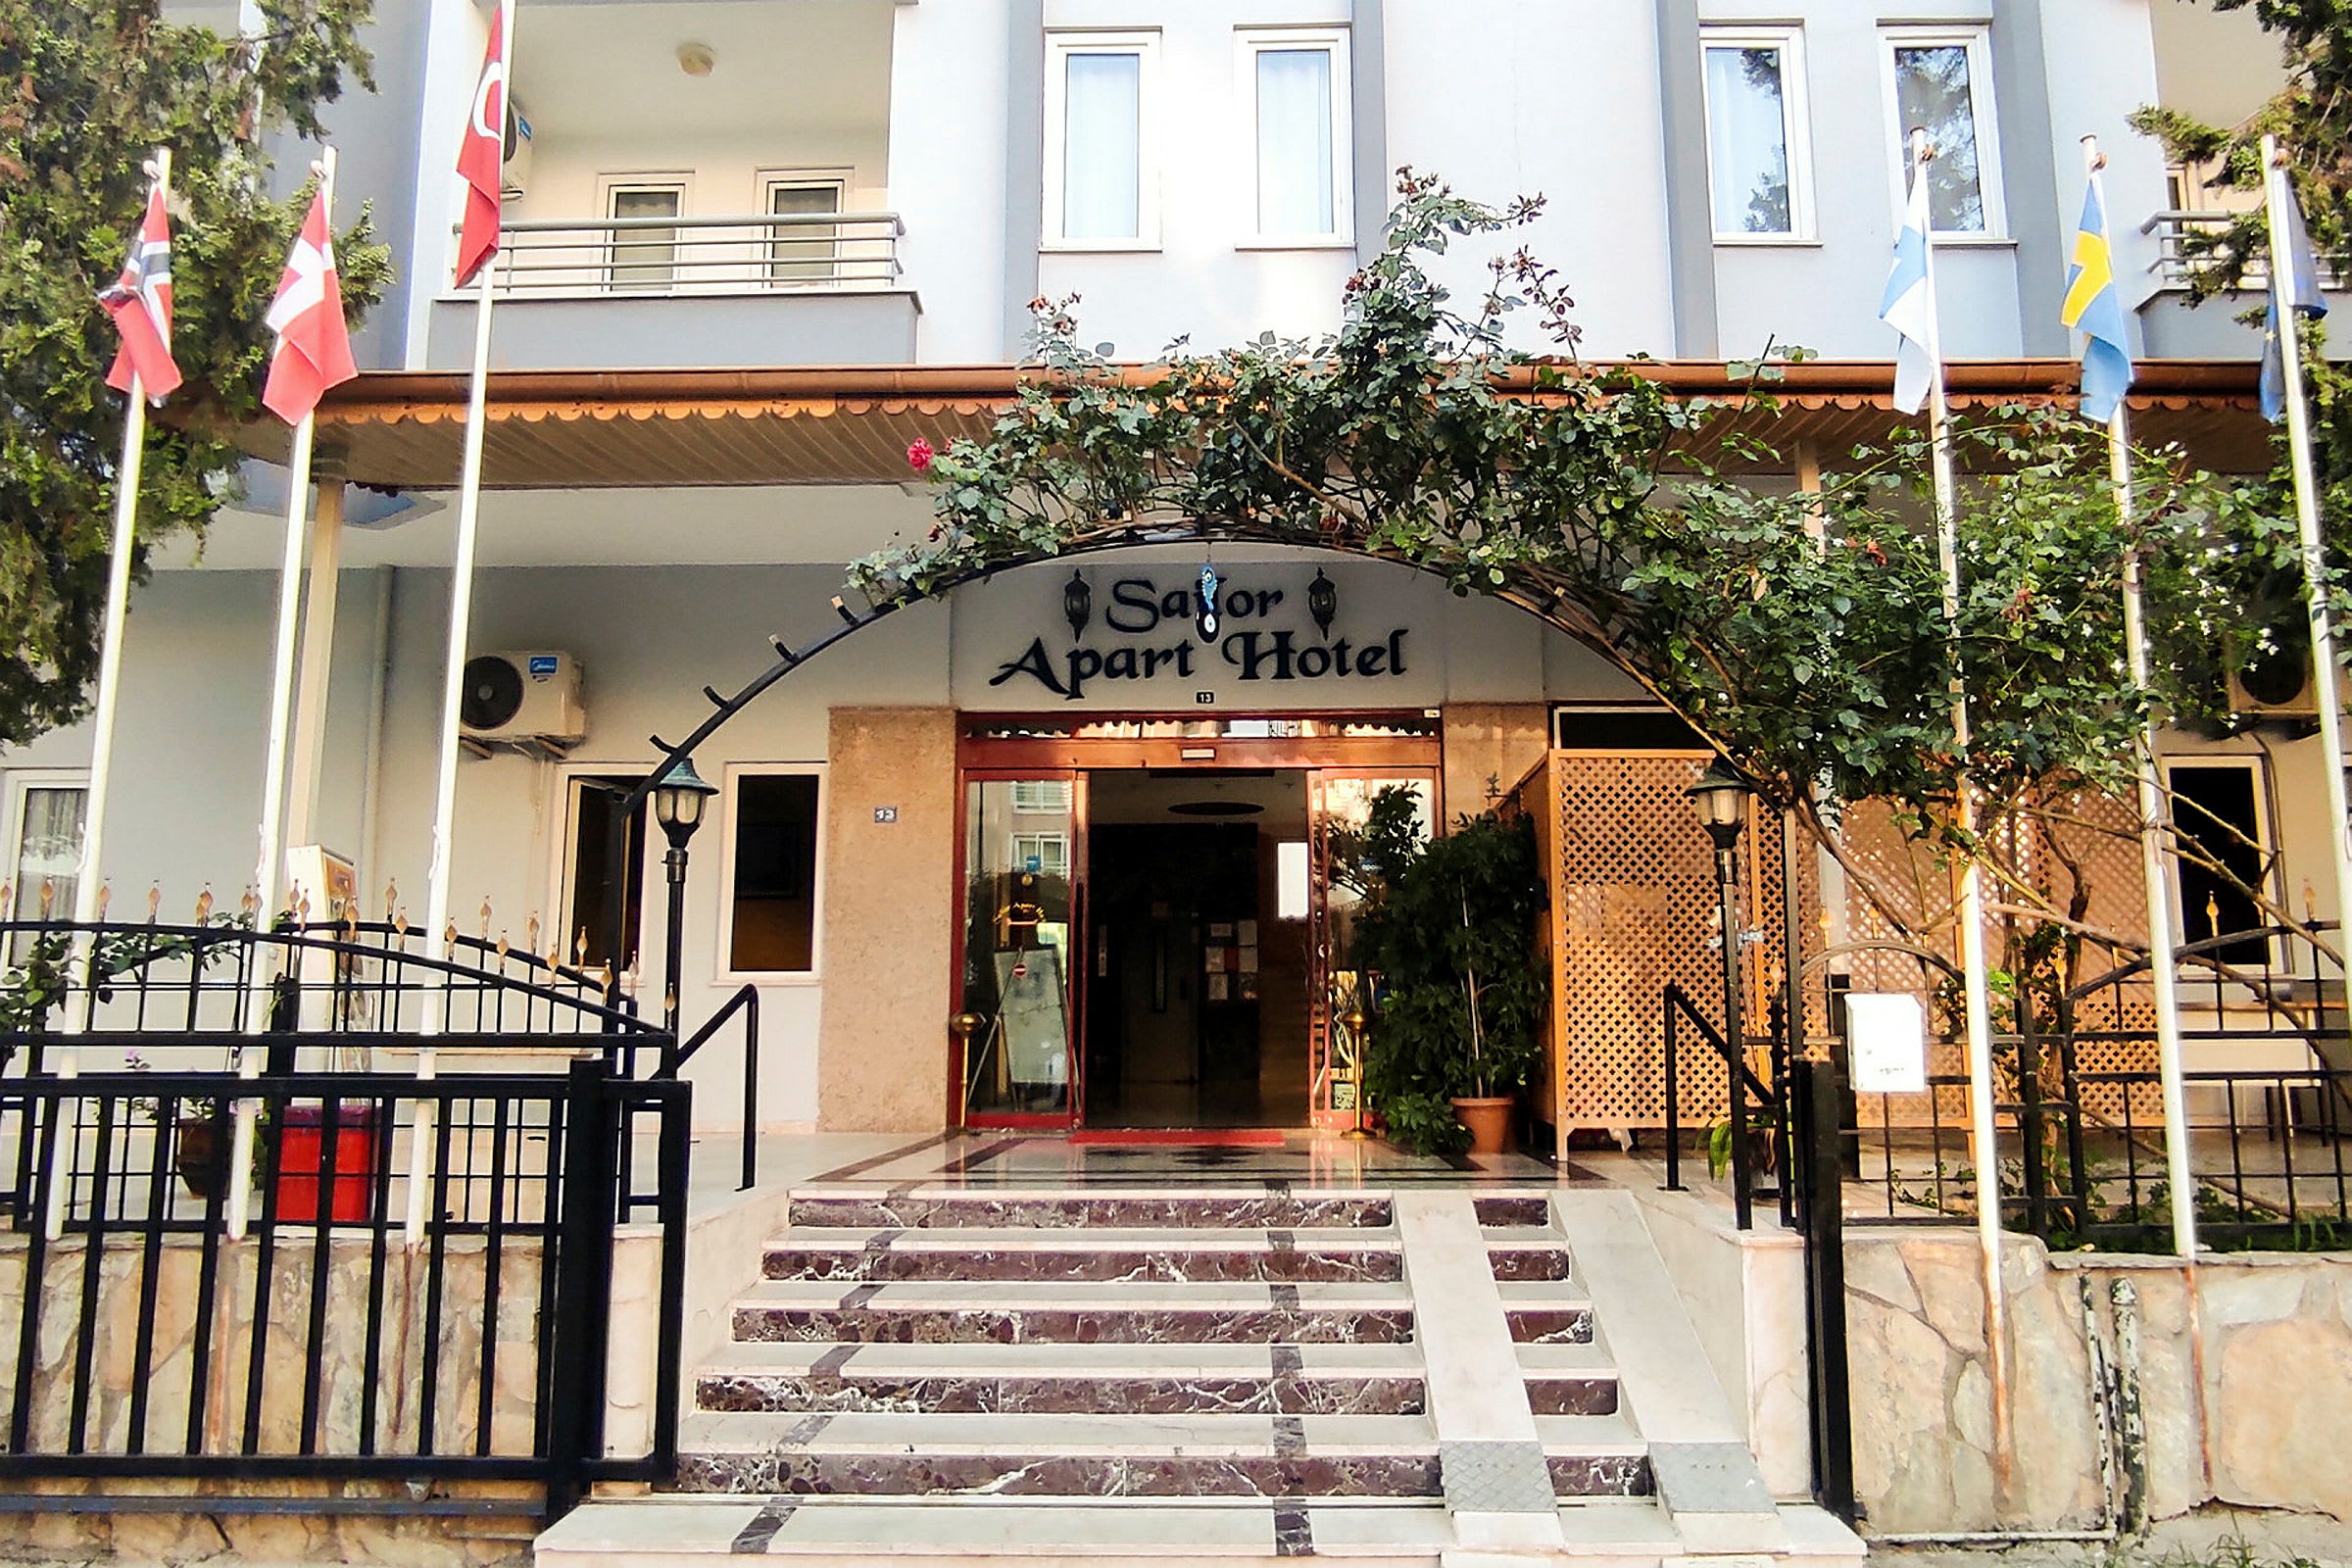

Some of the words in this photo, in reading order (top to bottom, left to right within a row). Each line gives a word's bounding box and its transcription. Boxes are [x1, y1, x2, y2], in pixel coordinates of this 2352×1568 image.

[989, 637, 1195, 700] Apart
[1222, 628, 1409, 680] Hotel
[1200, 693, 1211, 703] 13
[876, 809, 895, 821] 13
